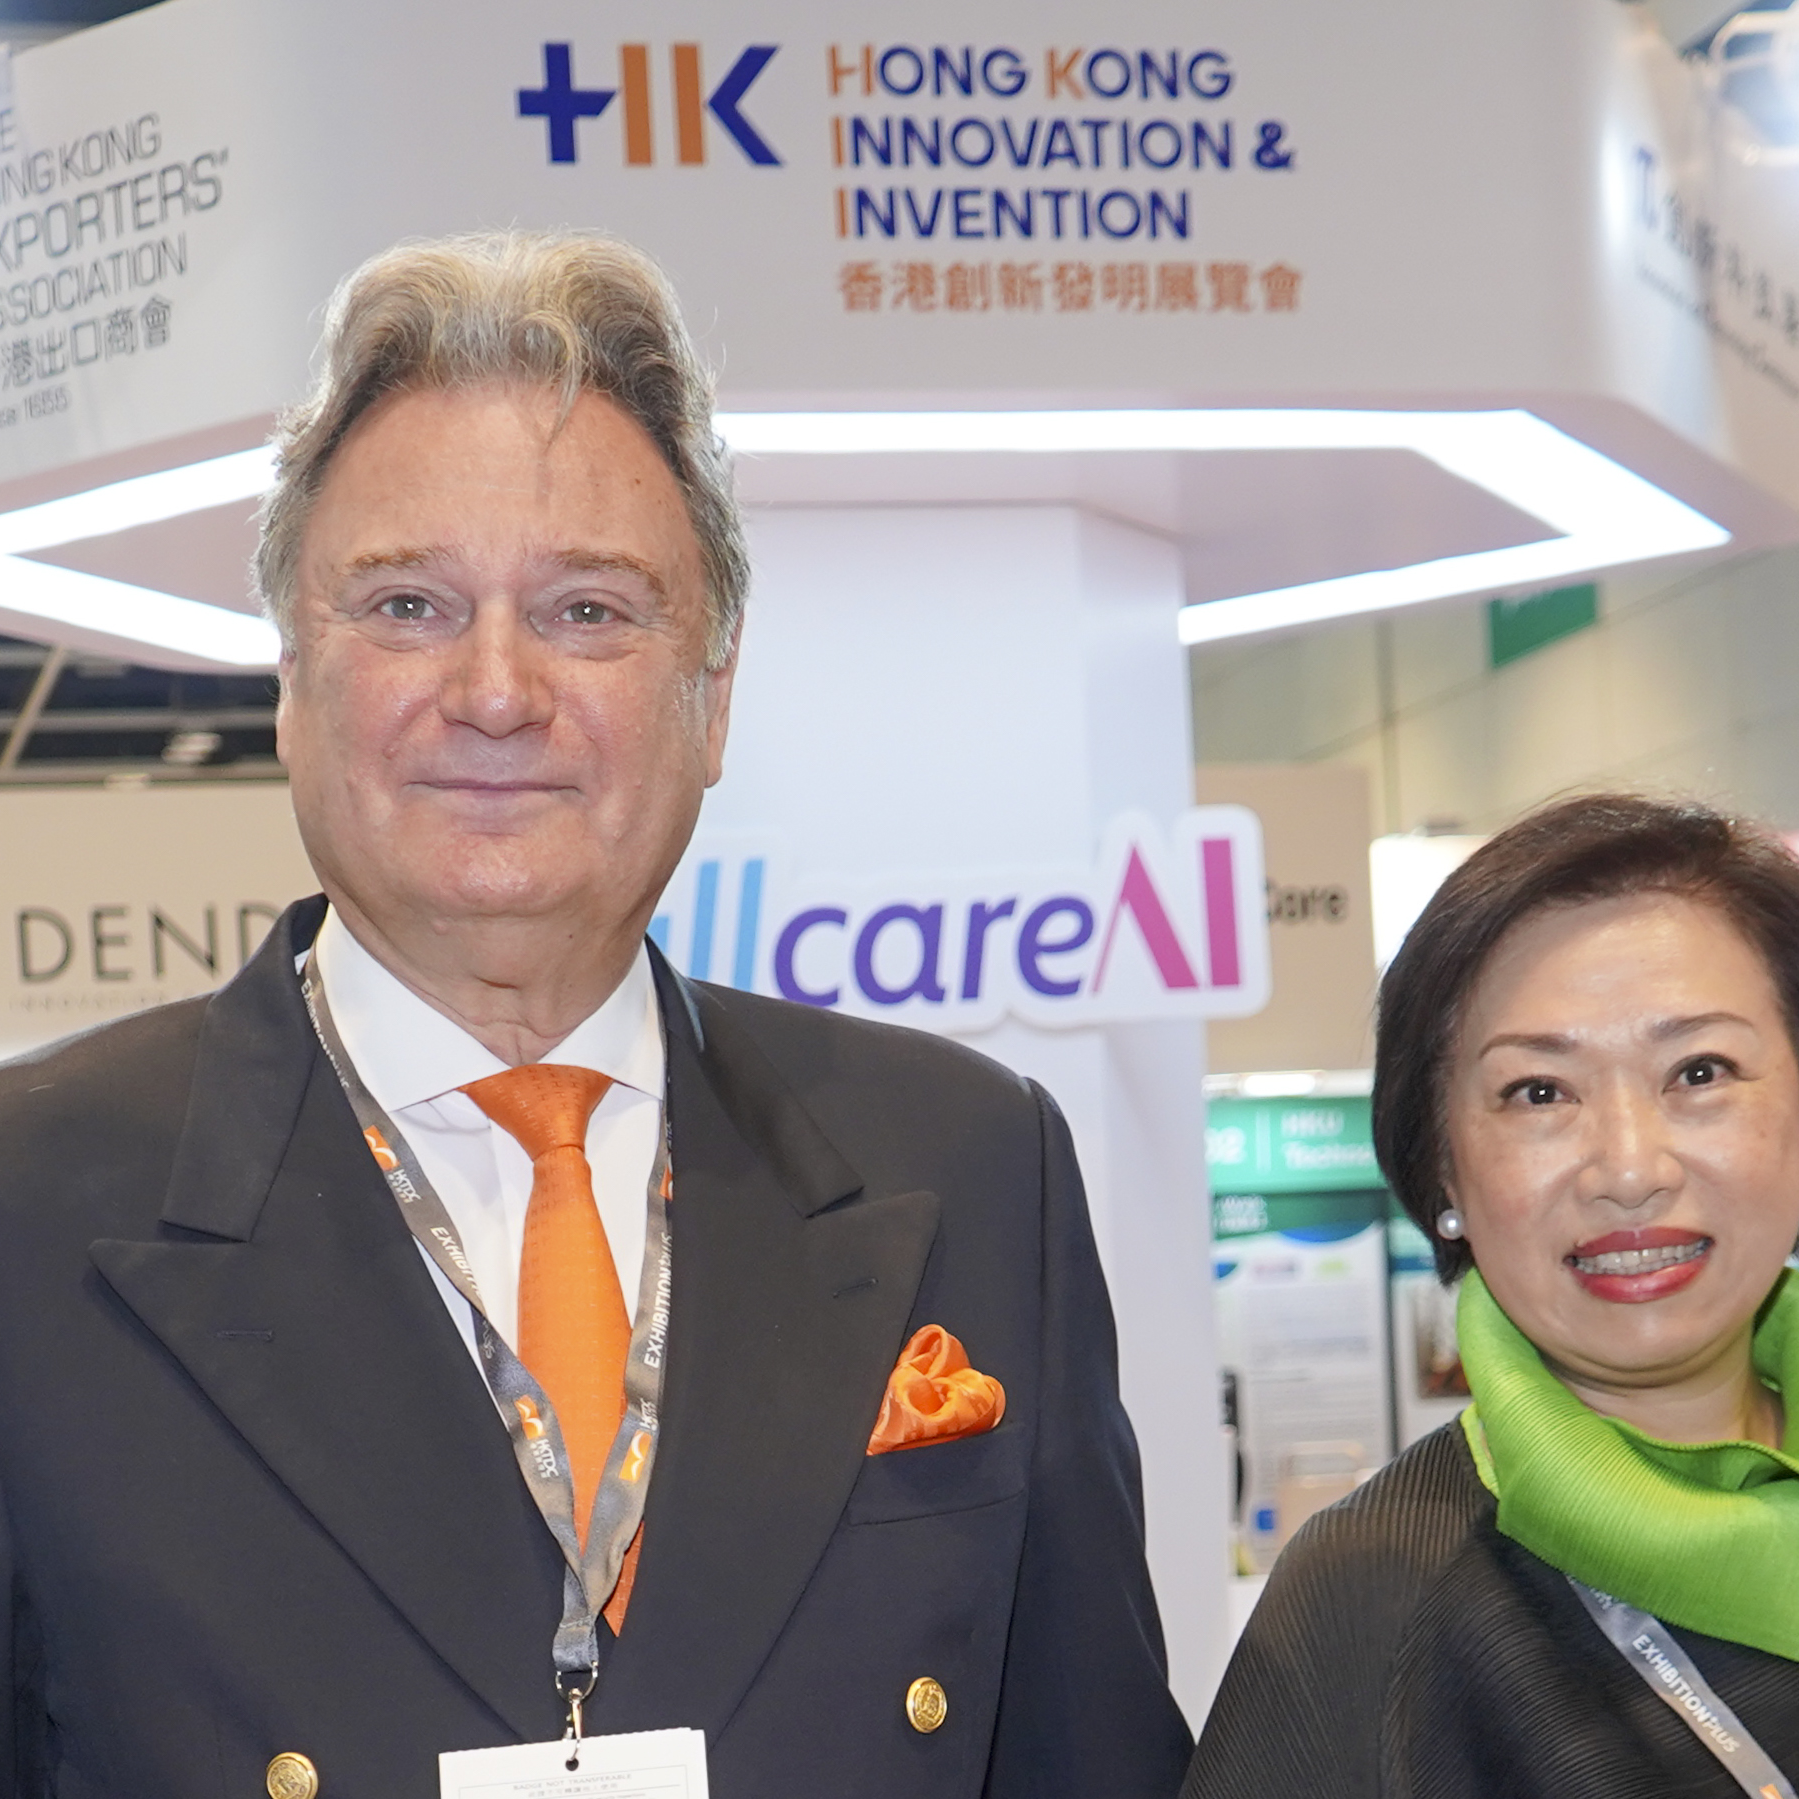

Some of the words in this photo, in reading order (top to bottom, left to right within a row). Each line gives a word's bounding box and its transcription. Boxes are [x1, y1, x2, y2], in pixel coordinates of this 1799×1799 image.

[827, 46, 1028, 100] HONG
[1044, 48, 1236, 100] KONG
[59, 112, 161, 186] KONG
[832, 117, 1233, 170] INNOVATION
[1250, 120, 1293, 170] &
[836, 187, 1191, 239] INVENTION
